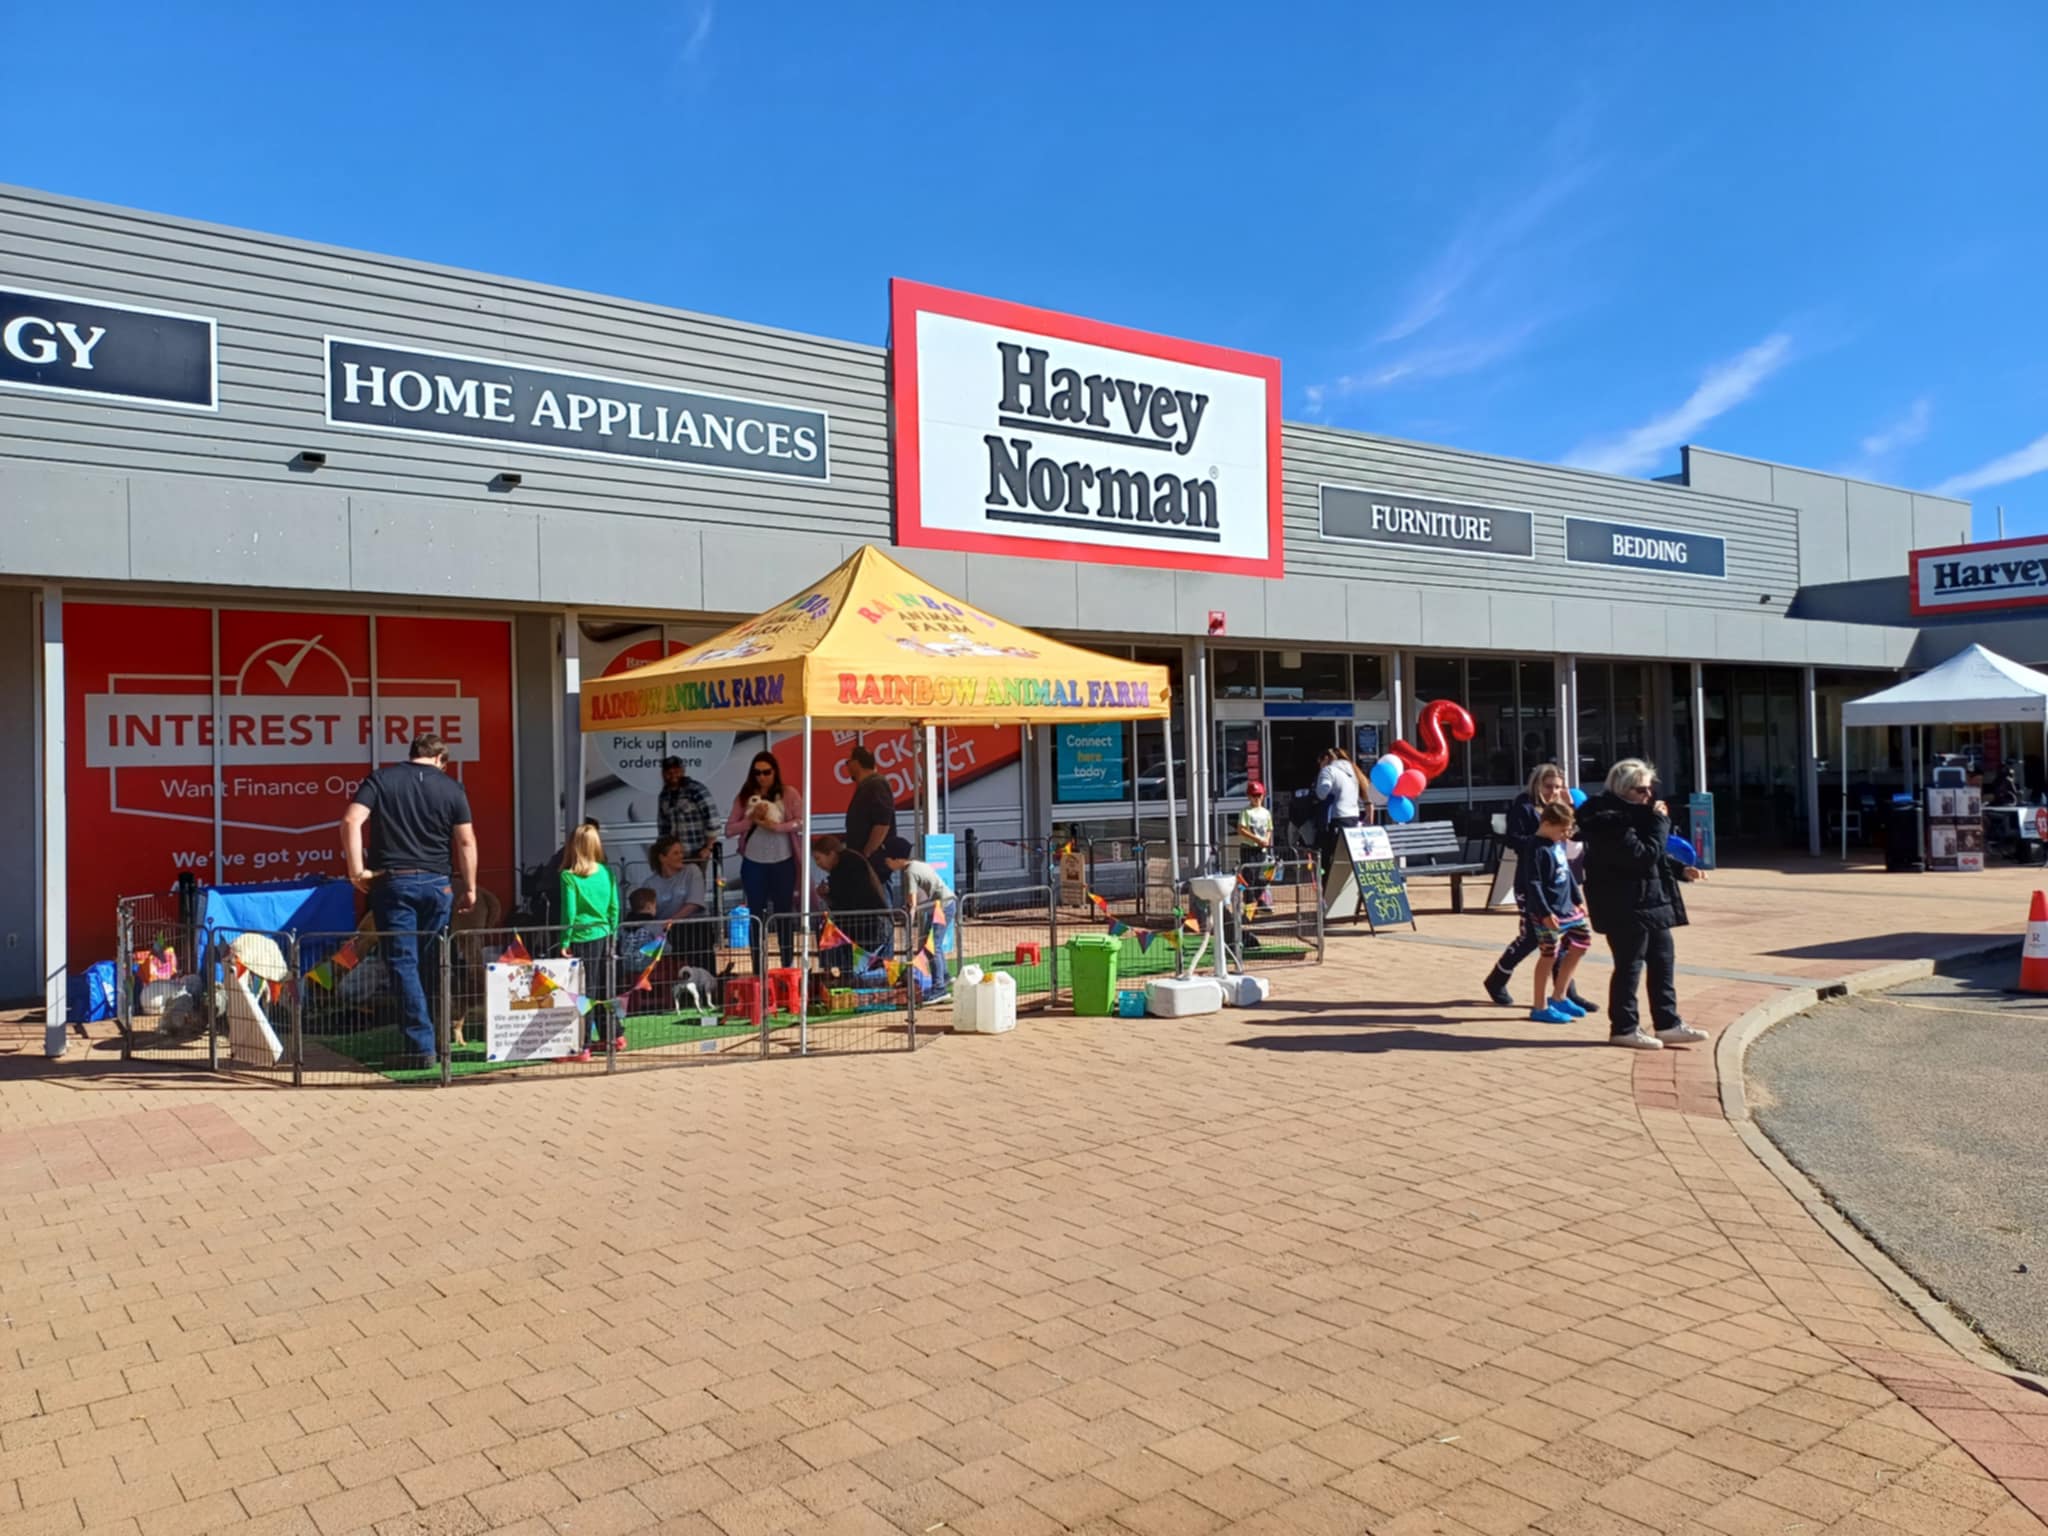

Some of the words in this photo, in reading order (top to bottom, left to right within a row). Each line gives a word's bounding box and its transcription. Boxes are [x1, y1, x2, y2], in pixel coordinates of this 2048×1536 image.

[343, 362, 515, 422] HOME
[530, 390, 818, 462] APPLIANCES
[997, 341, 1209, 456] Harvey
[983, 434, 1220, 529] Norman
[1371, 504, 1492, 542] FURNITURE
[1612, 533, 1687, 564] BEDDING
[591, 686, 662, 721] RAINBOW
[663, 680, 731, 713] ANIMAL
[731, 674, 784, 707] FARM
[837, 673, 976, 706] RAINBOW
[984, 677, 1083, 707] ANIMAL
[1086, 681, 1150, 707] FARM
[109, 714, 341, 746] INTEREST
[358, 715, 463, 745] FREE
[613, 736, 642, 750] Pick
[646, 740, 666, 752] up
[672, 736, 713, 749] online
[1066, 735, 1113, 747] Connect
[161, 778, 228, 798] Want
[234, 777, 319, 797] Finance
[1073, 765, 1107, 780] today
[253, 848, 289, 869] got
[296, 847, 333, 866] you
